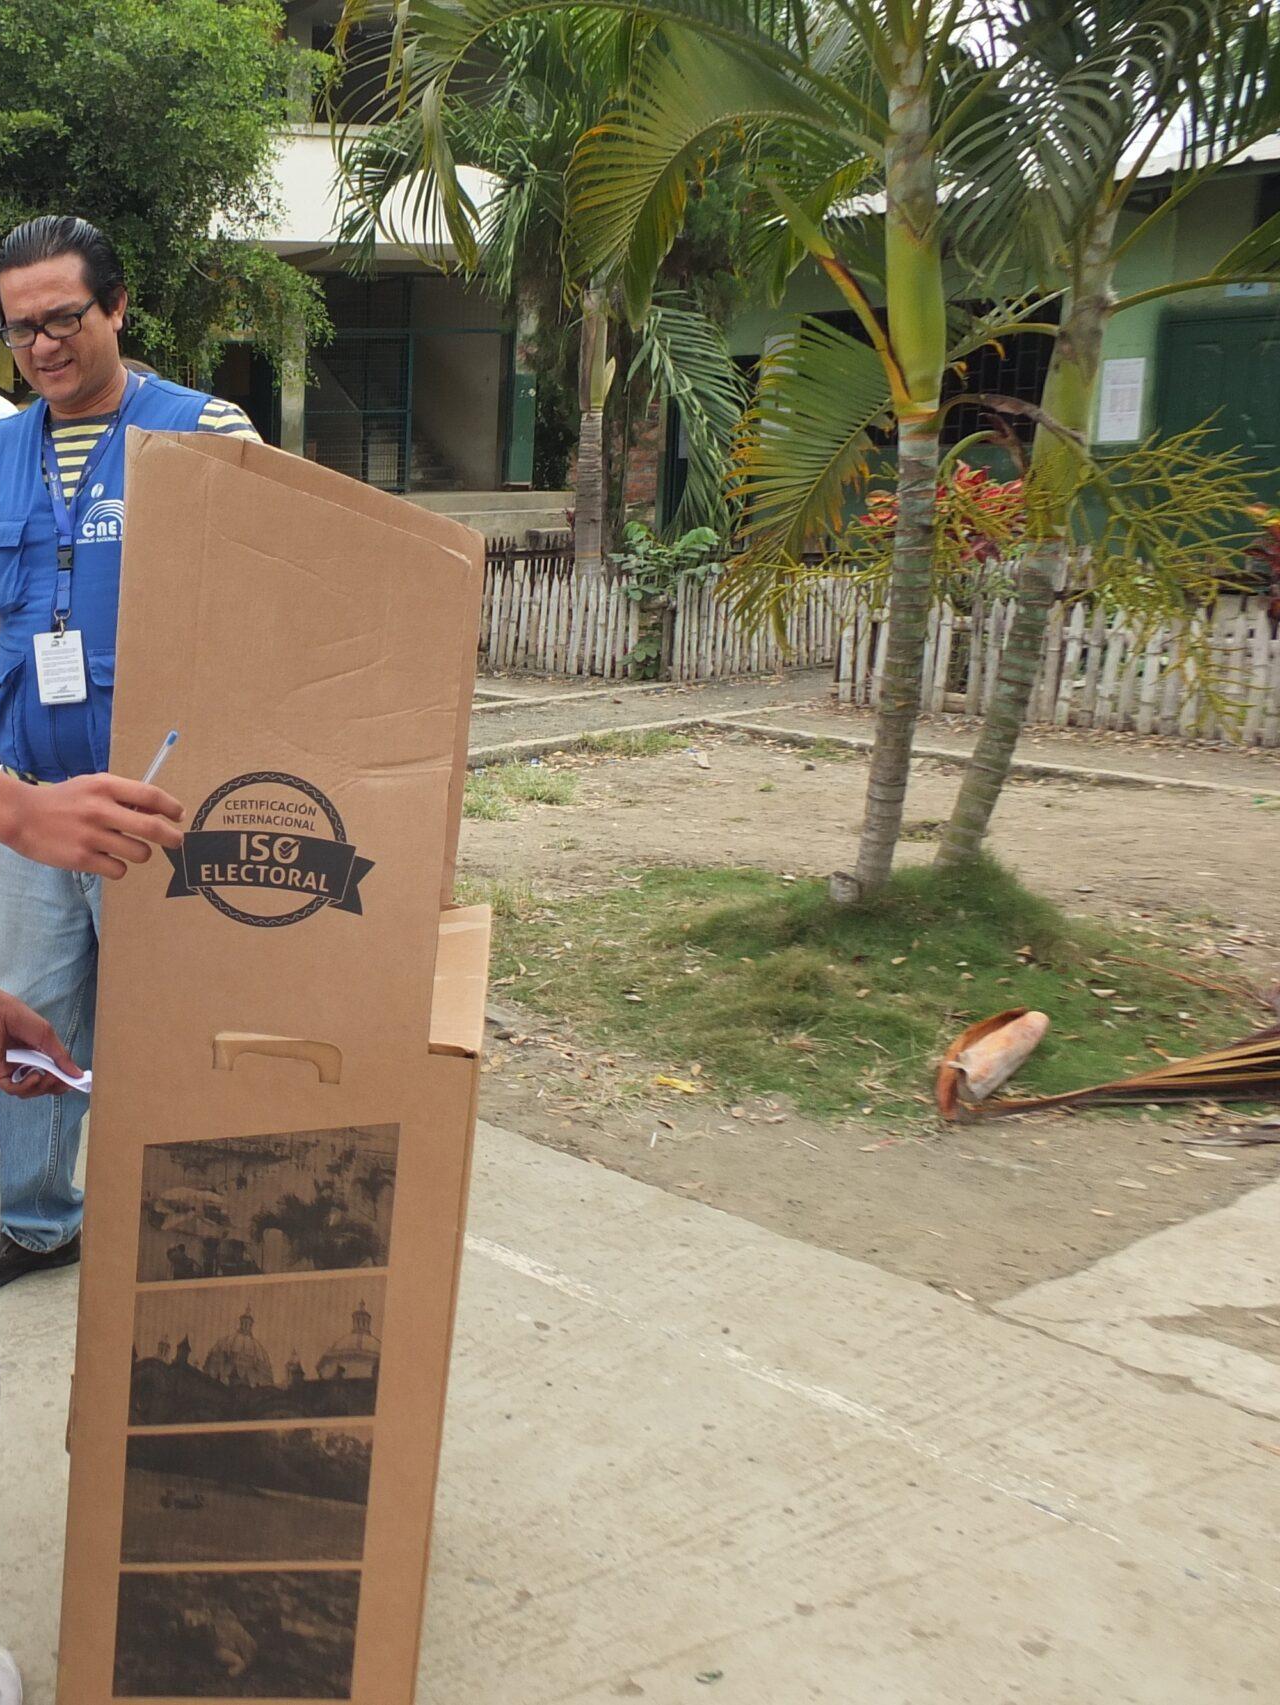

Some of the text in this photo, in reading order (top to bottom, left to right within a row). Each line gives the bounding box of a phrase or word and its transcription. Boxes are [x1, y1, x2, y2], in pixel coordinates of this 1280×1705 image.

[225, 800, 317, 816] CERTIFICACIÓN
[223, 814, 316, 831] INTERNACIONAL
[240, 833, 300, 864] ISO
[201, 864, 329, 892] ELECTORAL
